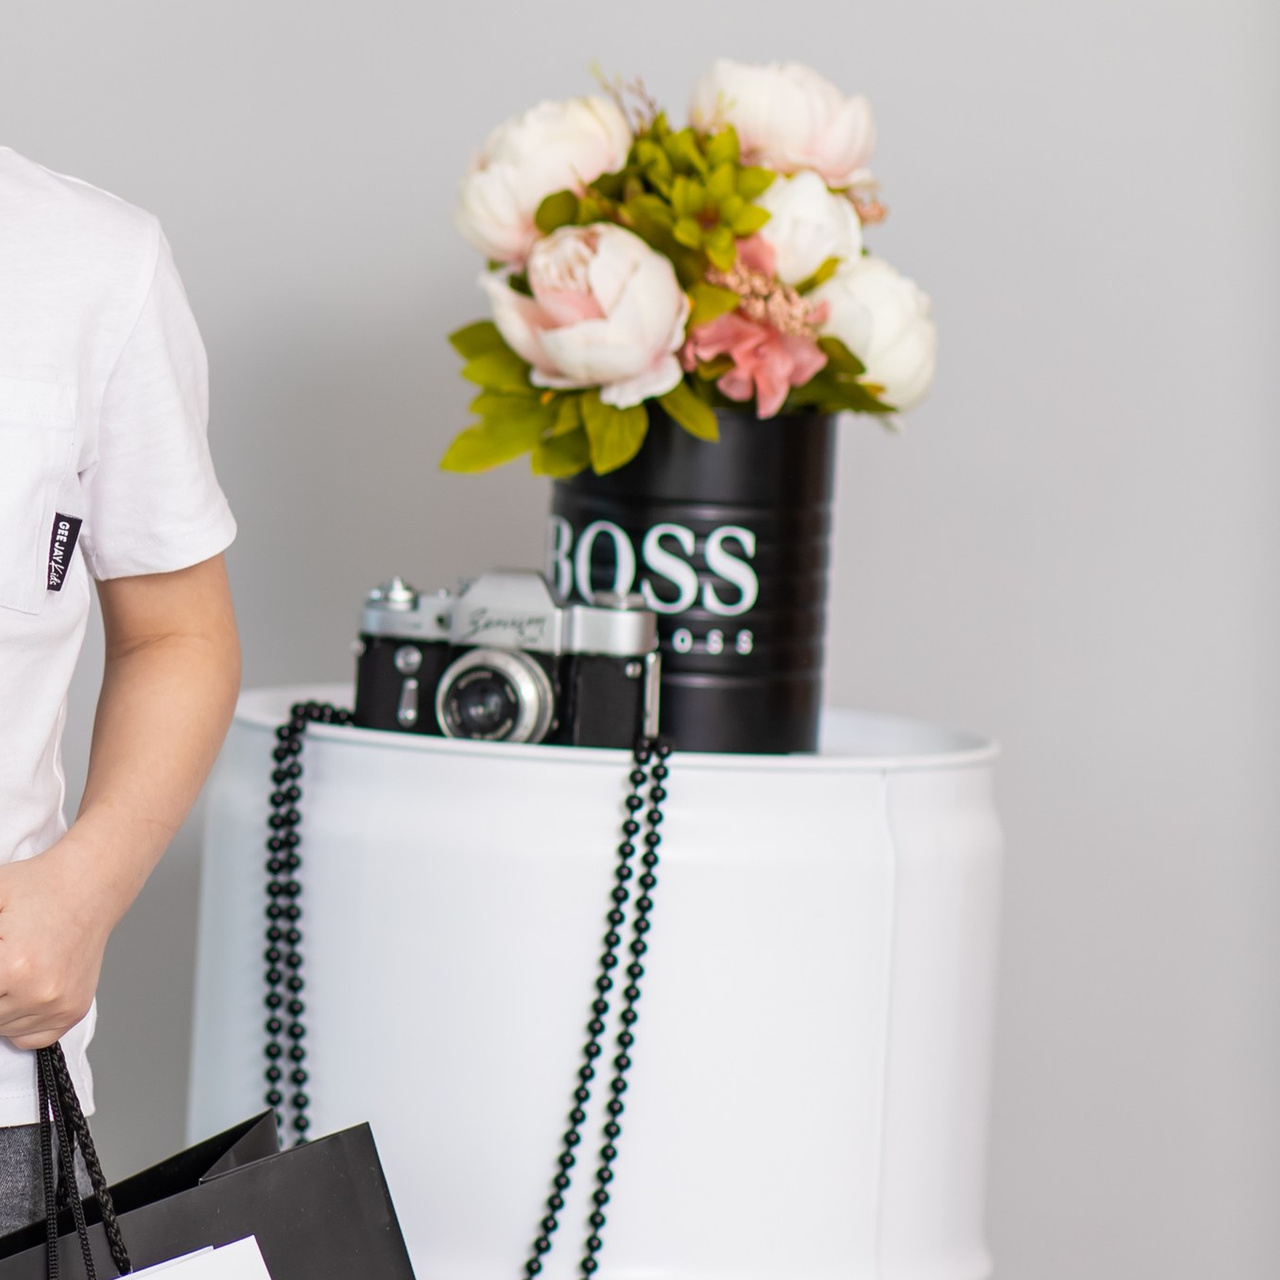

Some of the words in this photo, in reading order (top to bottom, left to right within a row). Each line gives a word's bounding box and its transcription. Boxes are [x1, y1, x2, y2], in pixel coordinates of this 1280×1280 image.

[56, 521, 70, 543] GEE
[52, 542, 65, 563] JAY
[672, 627, 754, 655] OSS
